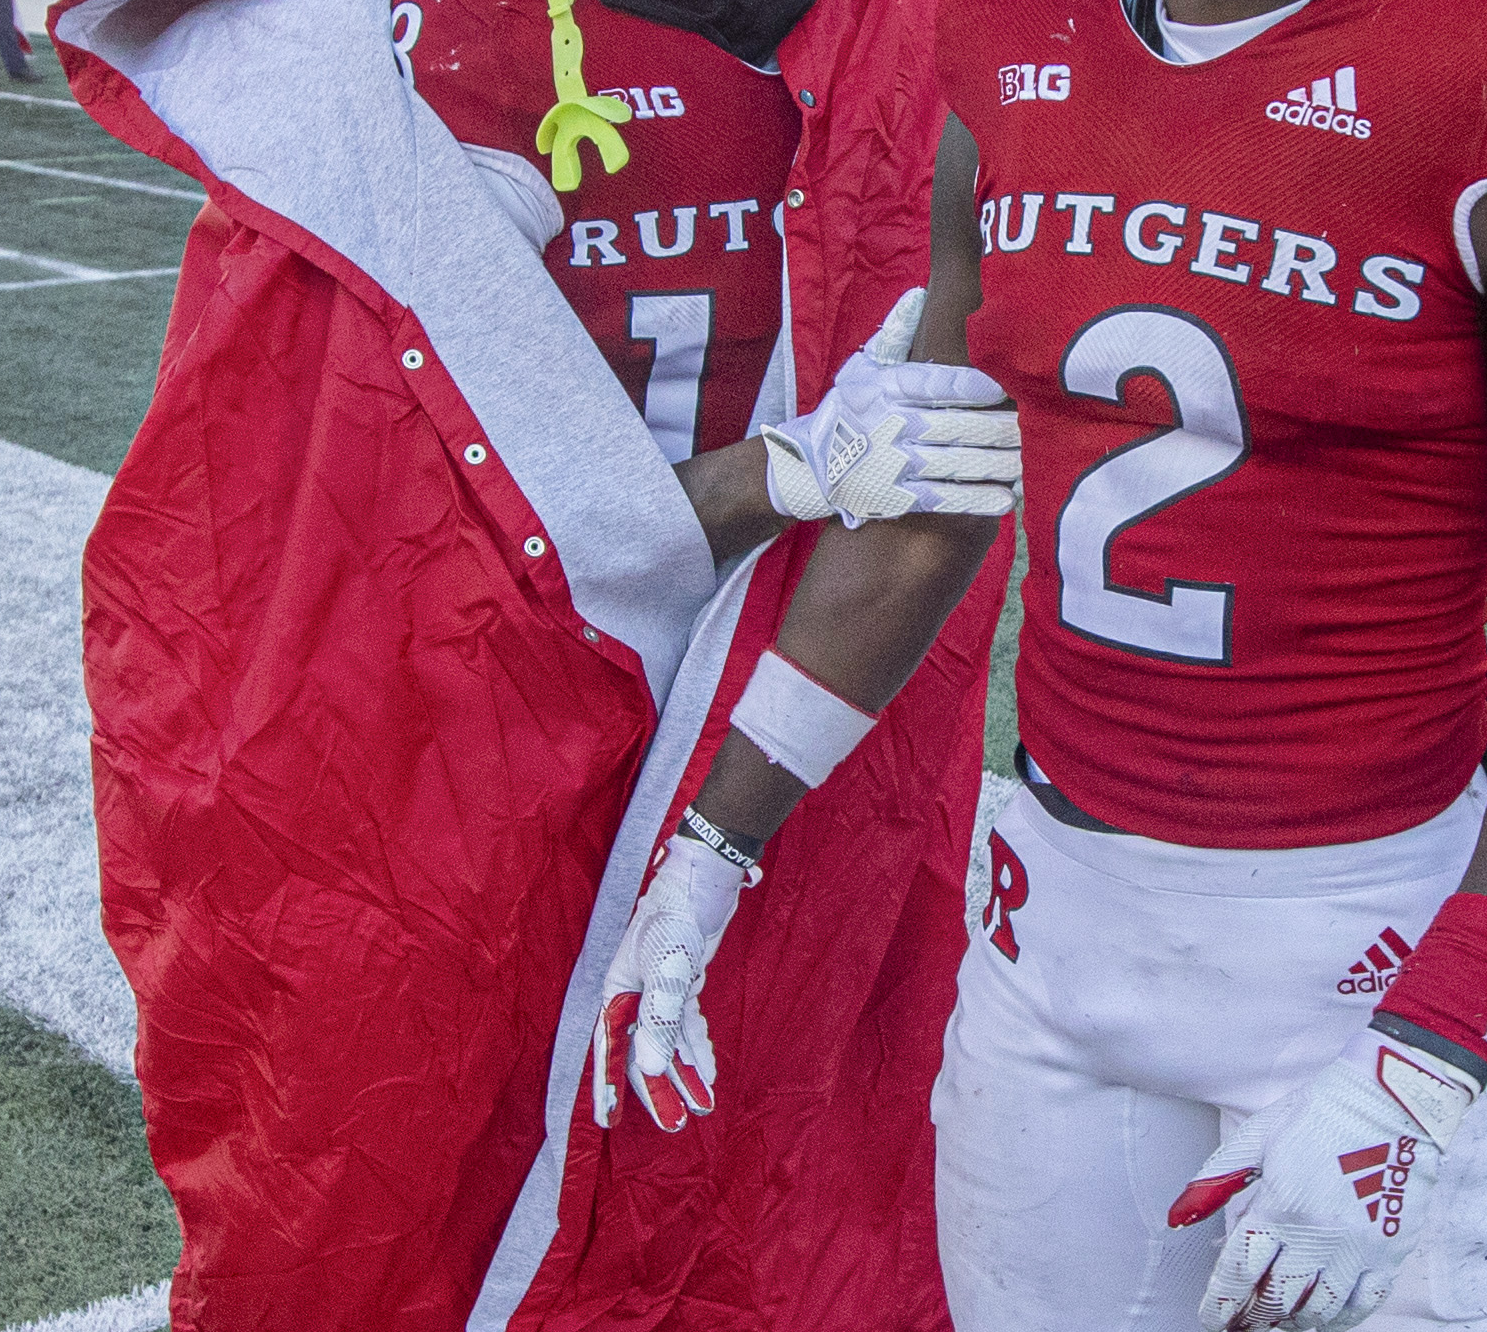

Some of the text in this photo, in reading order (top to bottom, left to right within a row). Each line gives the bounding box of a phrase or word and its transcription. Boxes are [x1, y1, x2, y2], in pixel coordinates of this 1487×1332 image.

[1266, 101, 1372, 140] adidas
[569, 198, 783, 267] RUT
[981, 191, 1426, 322] RUTGERS
[828, 437, 865, 481] adidas
[1058, 303, 1251, 668] 2
[690, 815, 723, 848] LIVES
[982, 826, 1029, 965] R
[1382, 1134, 1418, 1238] adidas
